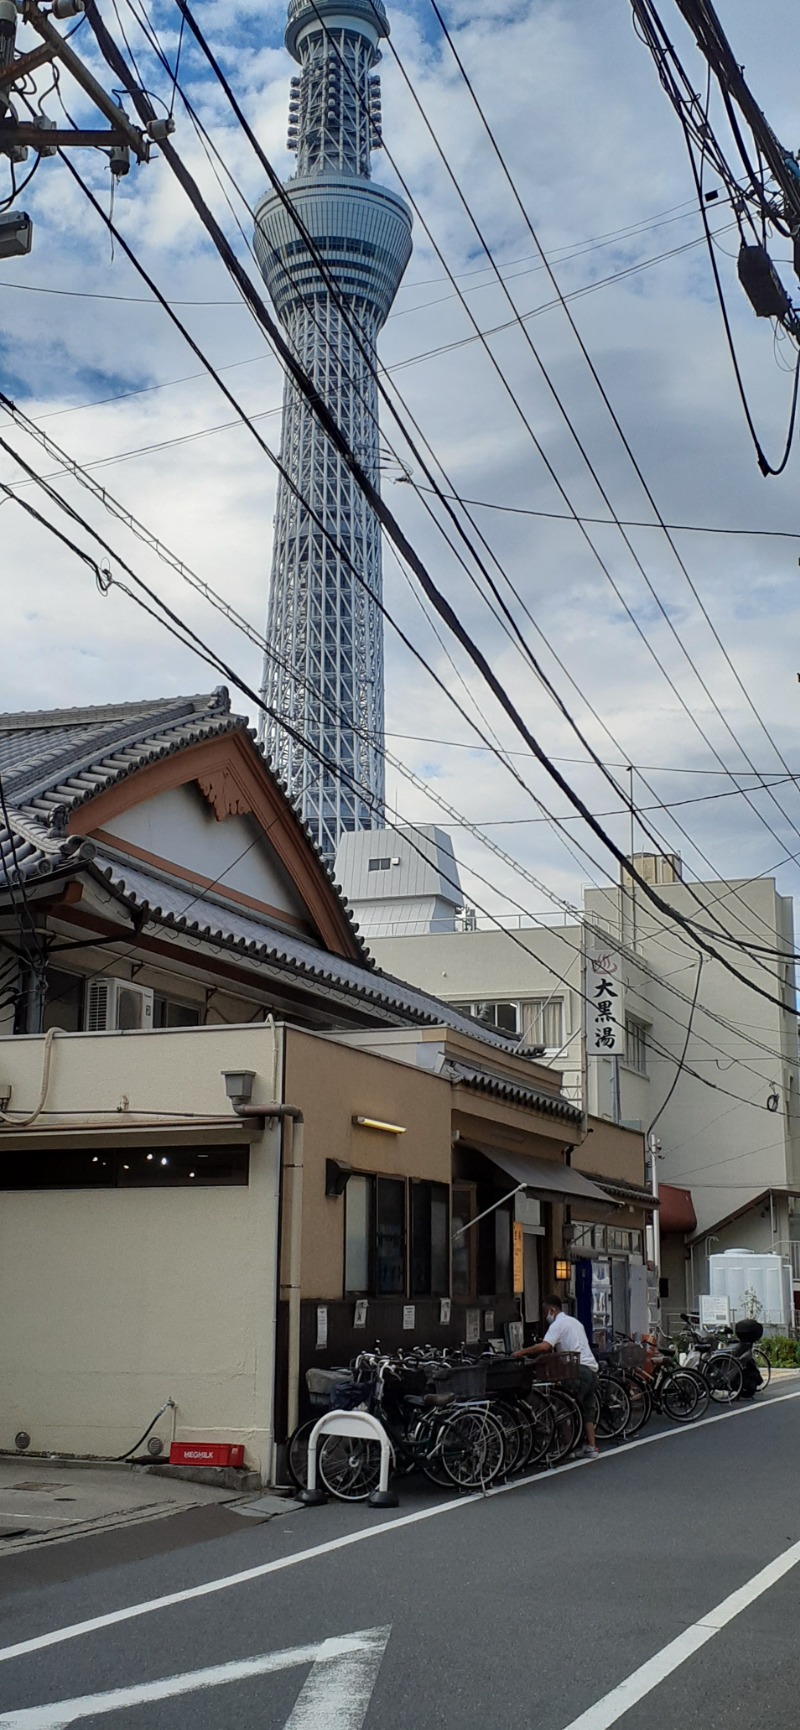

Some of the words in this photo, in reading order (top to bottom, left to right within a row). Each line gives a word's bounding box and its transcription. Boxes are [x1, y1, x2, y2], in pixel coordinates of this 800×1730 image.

[593, 978, 618, 1049] 大黒湯
[183, 1451, 213, 1459] MEGMILK
